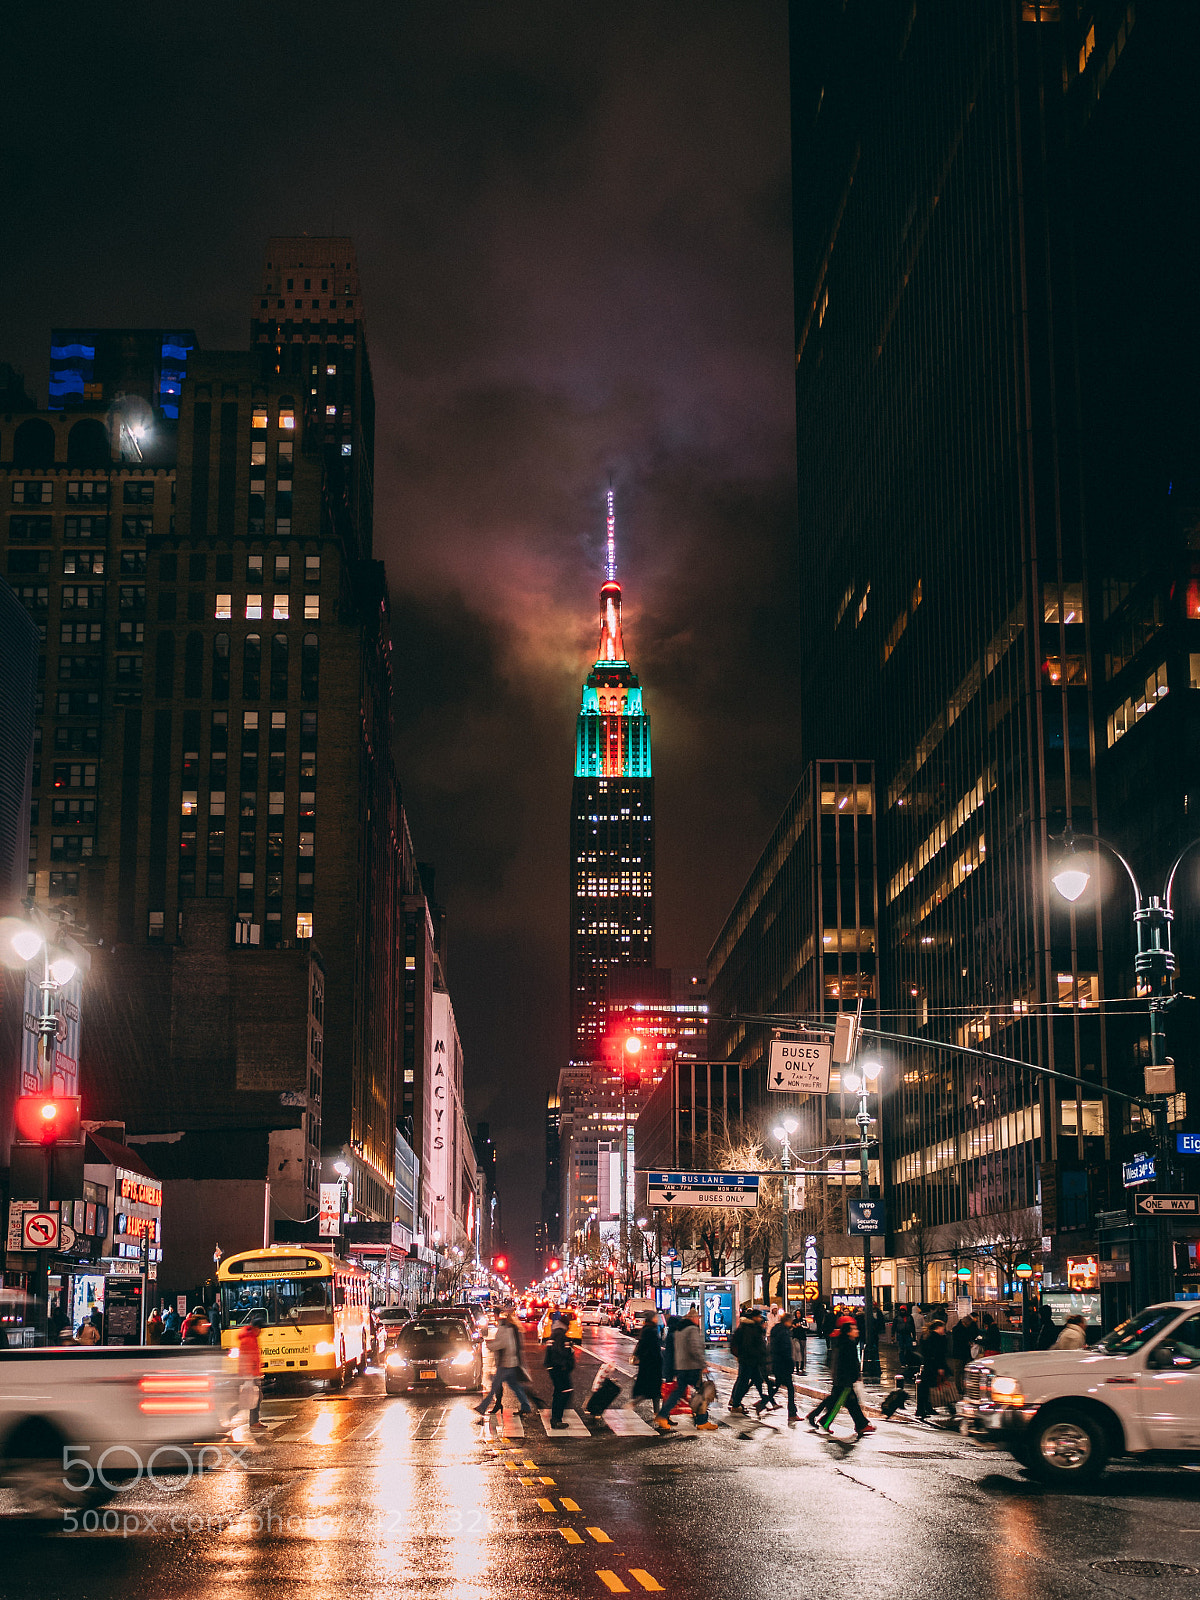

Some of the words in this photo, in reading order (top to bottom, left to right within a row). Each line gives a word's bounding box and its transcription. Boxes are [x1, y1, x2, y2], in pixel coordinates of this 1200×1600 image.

[782, 1047, 820, 1059] BUSES
[785, 1060, 815, 1072] ONLY
[24, 1074, 37, 1092] BEER
[434, 1039, 446, 1150] MACY'S
[1126, 1166, 1138, 1180] West
[681, 1175, 699, 1183] BUS
[702, 1176, 725, 1184] LANE
[139, 1183, 162, 1207] CAMERAS
[698, 1194, 723, 1202] BUSES
[725, 1195, 745, 1203] ONLY
[1145, 1200, 1163, 1209] ONE
[1170, 1200, 1190, 1209] WAY
[805, 1234, 818, 1281] PARK
[833, 1296, 865, 1307] PARK
